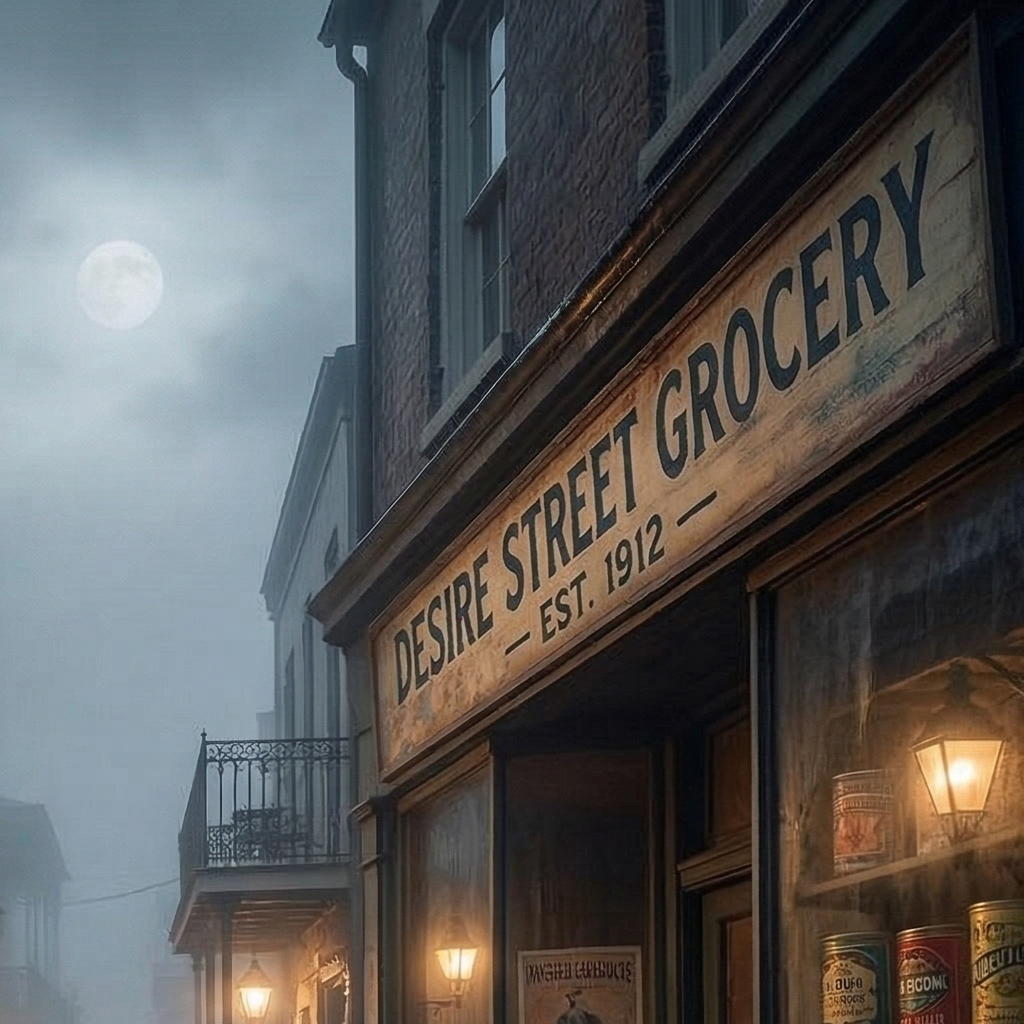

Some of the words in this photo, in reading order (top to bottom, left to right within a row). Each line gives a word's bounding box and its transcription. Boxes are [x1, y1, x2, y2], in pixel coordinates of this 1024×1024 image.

[394, 549, 494, 706] DESIRE
[502, 406, 638, 612] STREET
[656, 129, 934, 480] GROCERY
[539, 570, 594, 643] EST.
[604, 513, 664, 595] 1912
